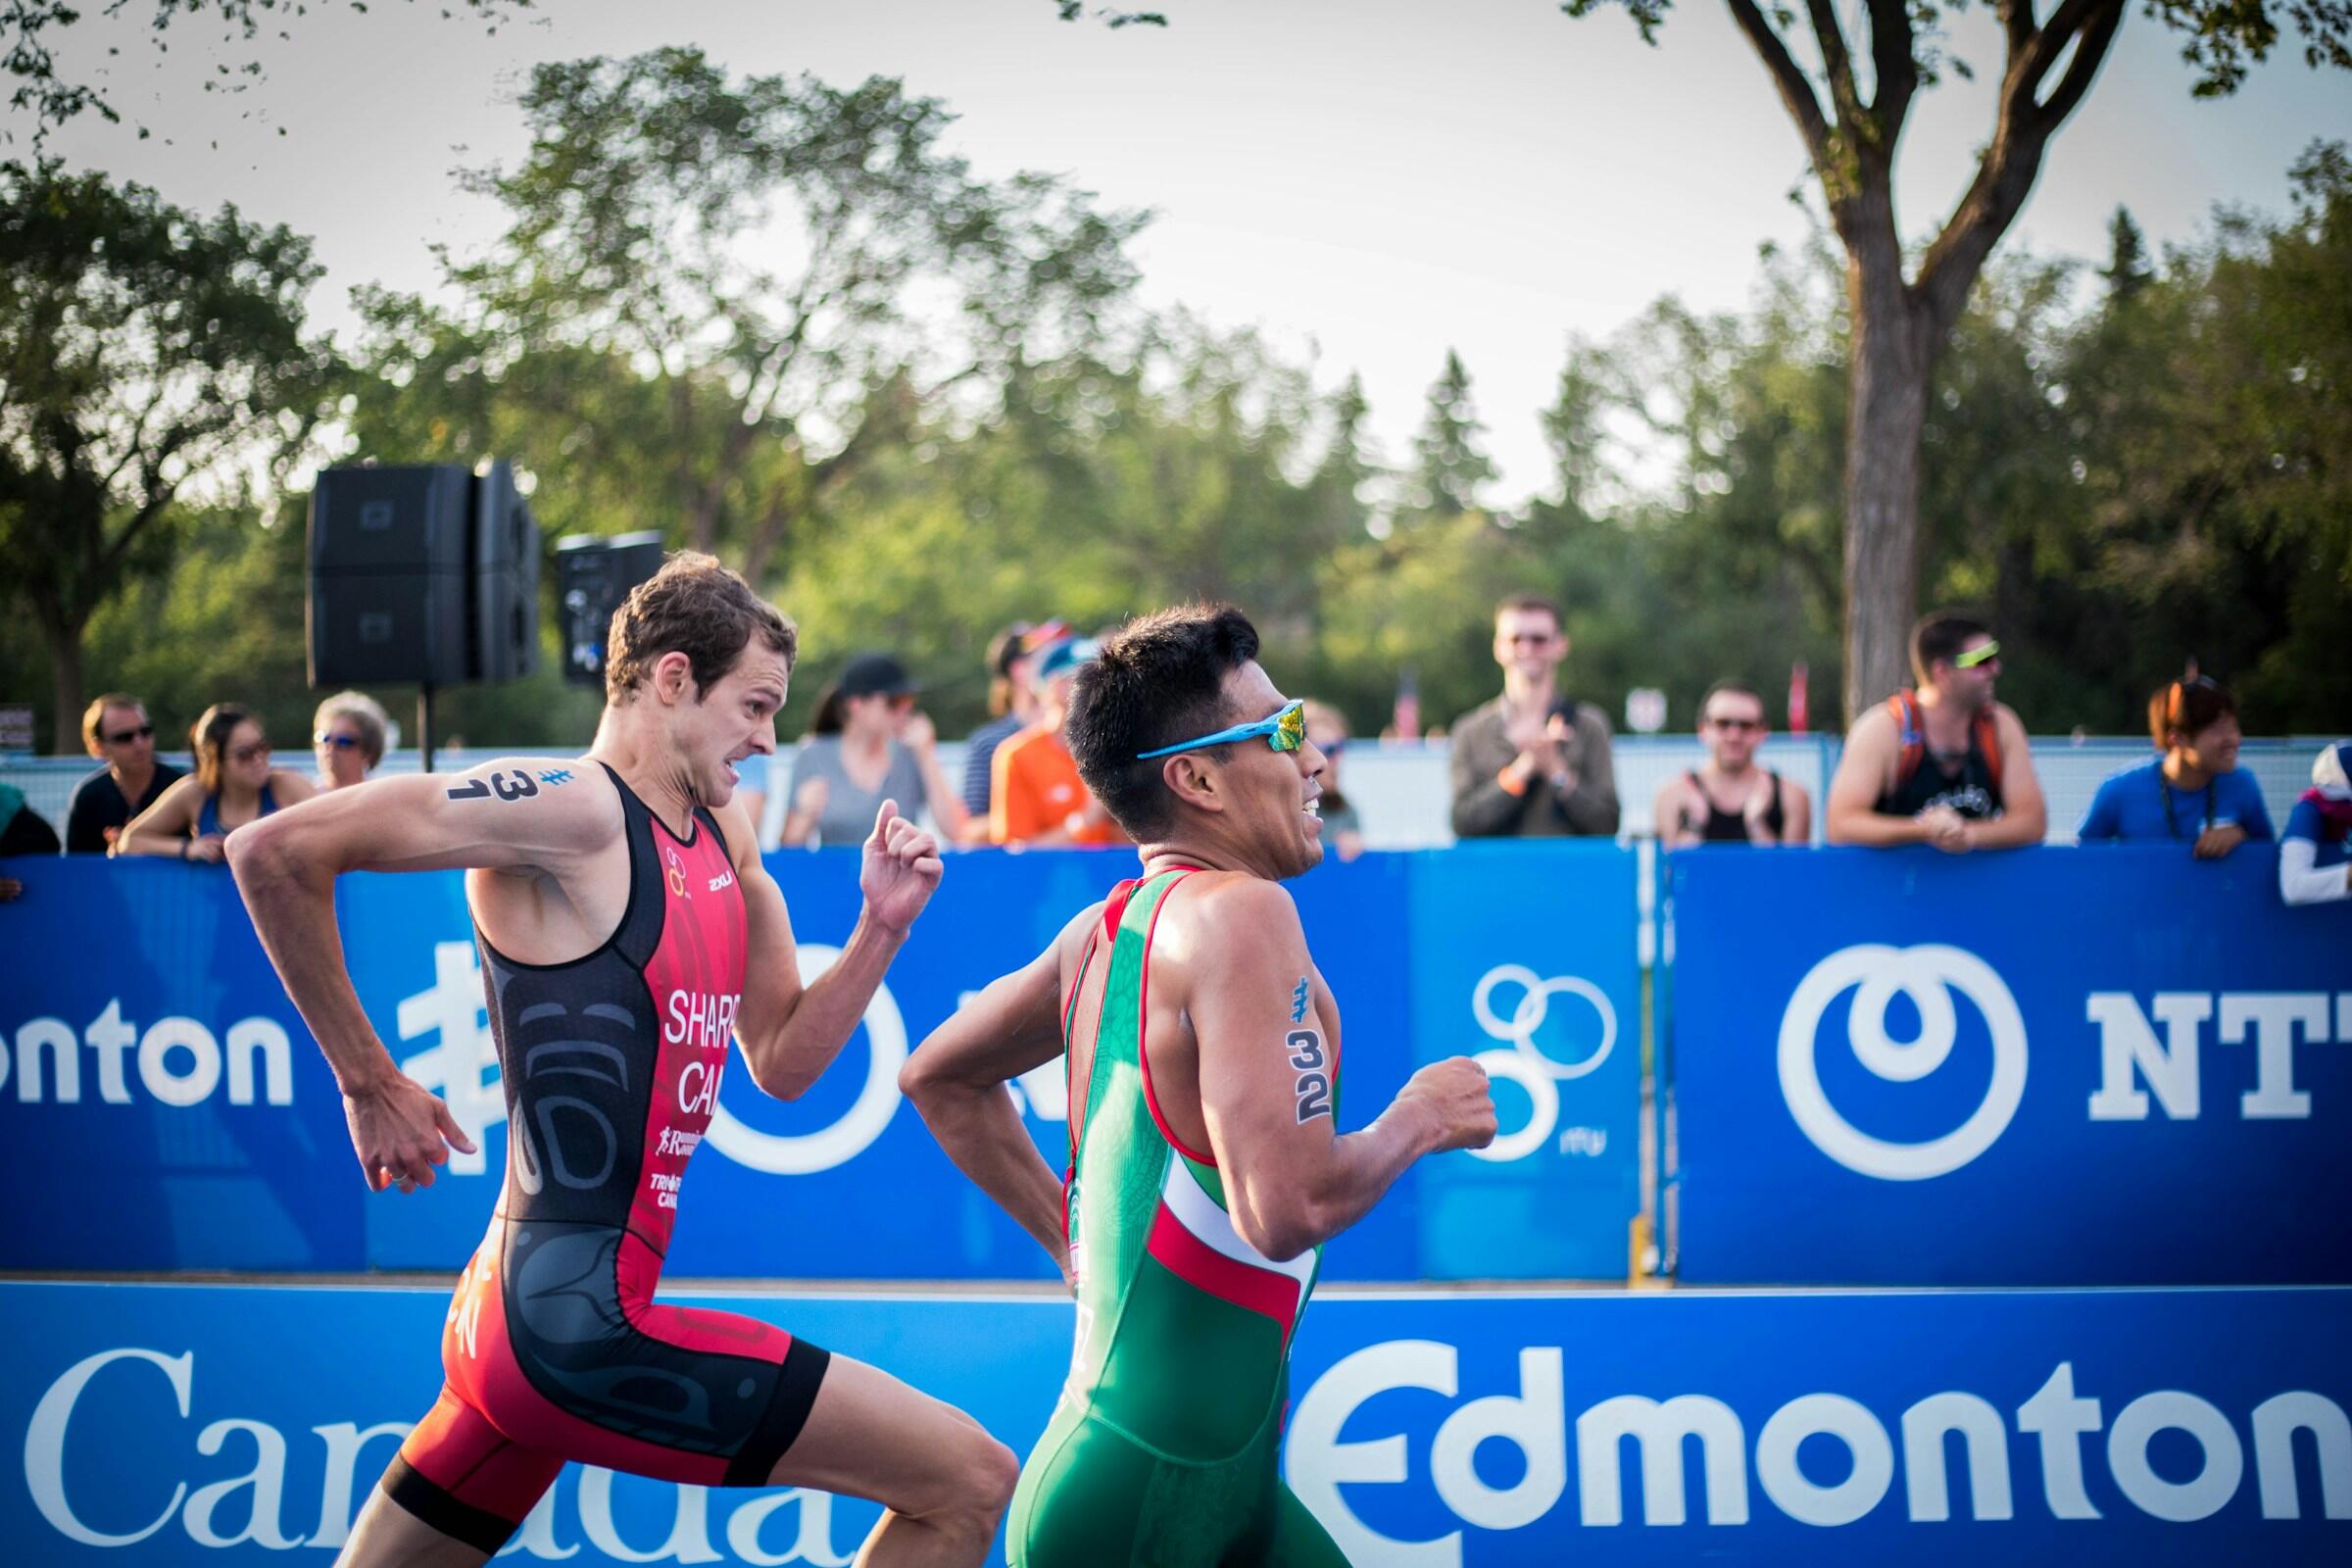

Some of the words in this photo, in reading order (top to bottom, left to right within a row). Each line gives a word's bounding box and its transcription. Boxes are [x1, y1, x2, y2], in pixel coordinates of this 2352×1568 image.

[447, 768, 540, 802] 31
[708, 870, 733, 892] 2XU
[0, 998, 293, 1106] nton
[1286, 1029, 1331, 1125] 32
[2085, 992, 2352, 1121] NT
[1285, 1339, 2352, 1568] Edmonton
